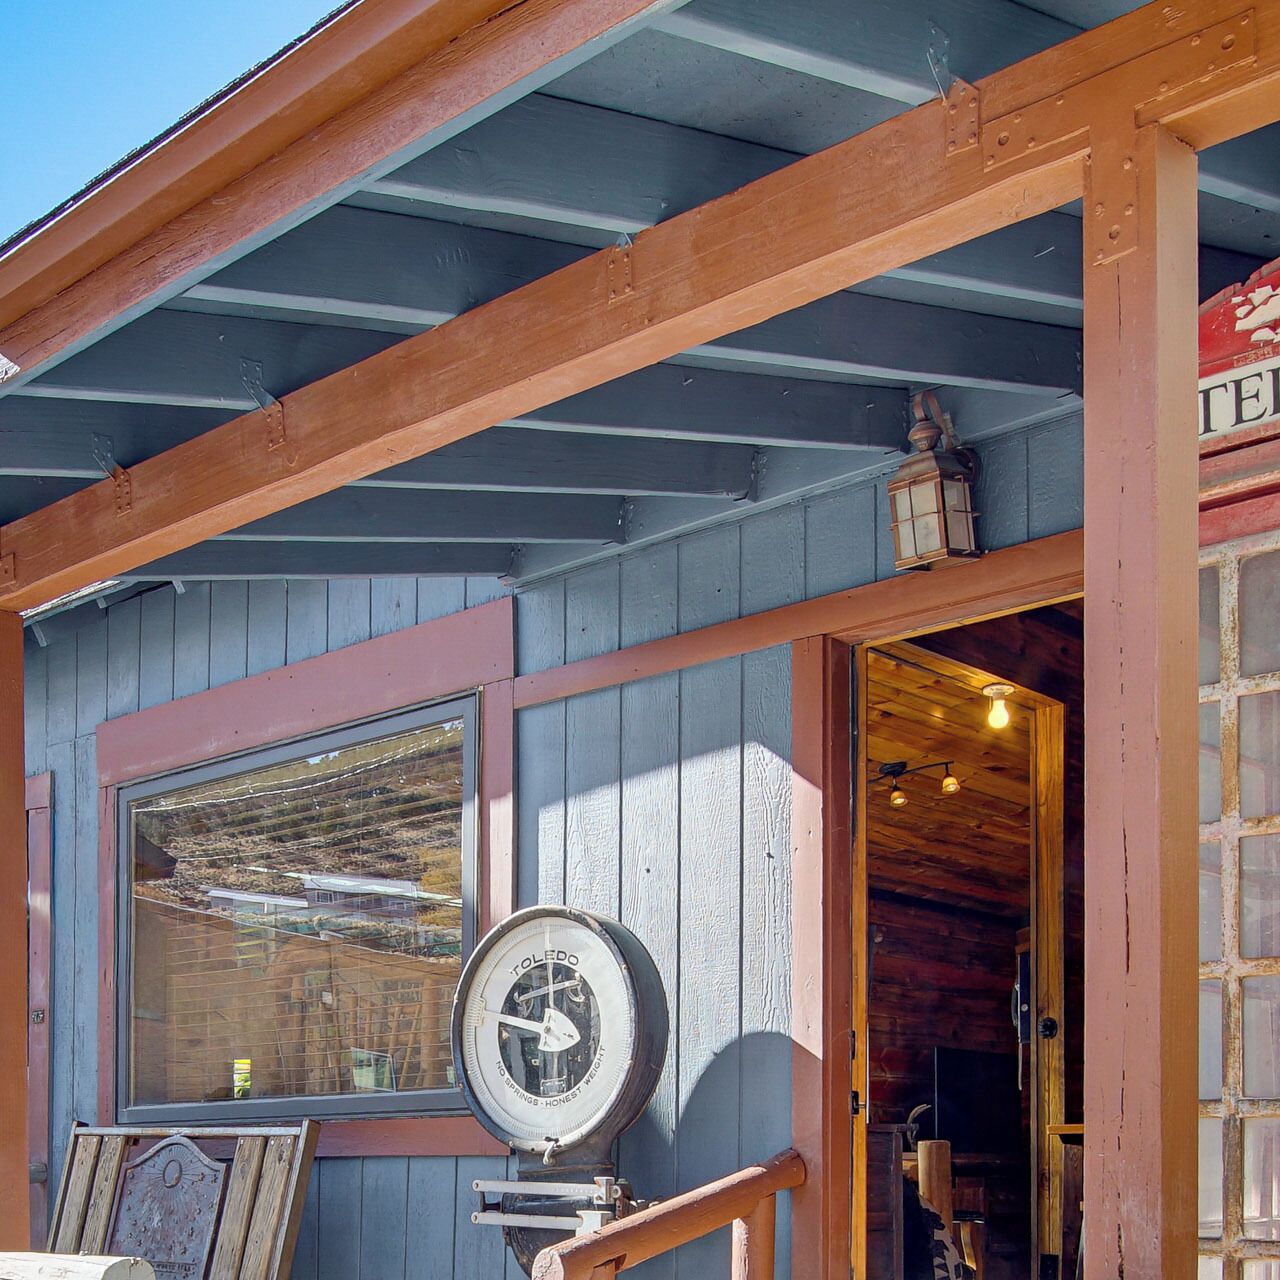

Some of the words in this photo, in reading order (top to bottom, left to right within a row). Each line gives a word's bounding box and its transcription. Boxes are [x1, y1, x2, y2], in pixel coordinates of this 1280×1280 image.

[510, 949, 580, 977] TOLEDO
[495, 1060, 506, 1077] NO
[504, 1077, 540, 1107] SPRINGS
[544, 1086, 583, 1108] HONEST
[583, 1044, 607, 1087] WEIGHT
